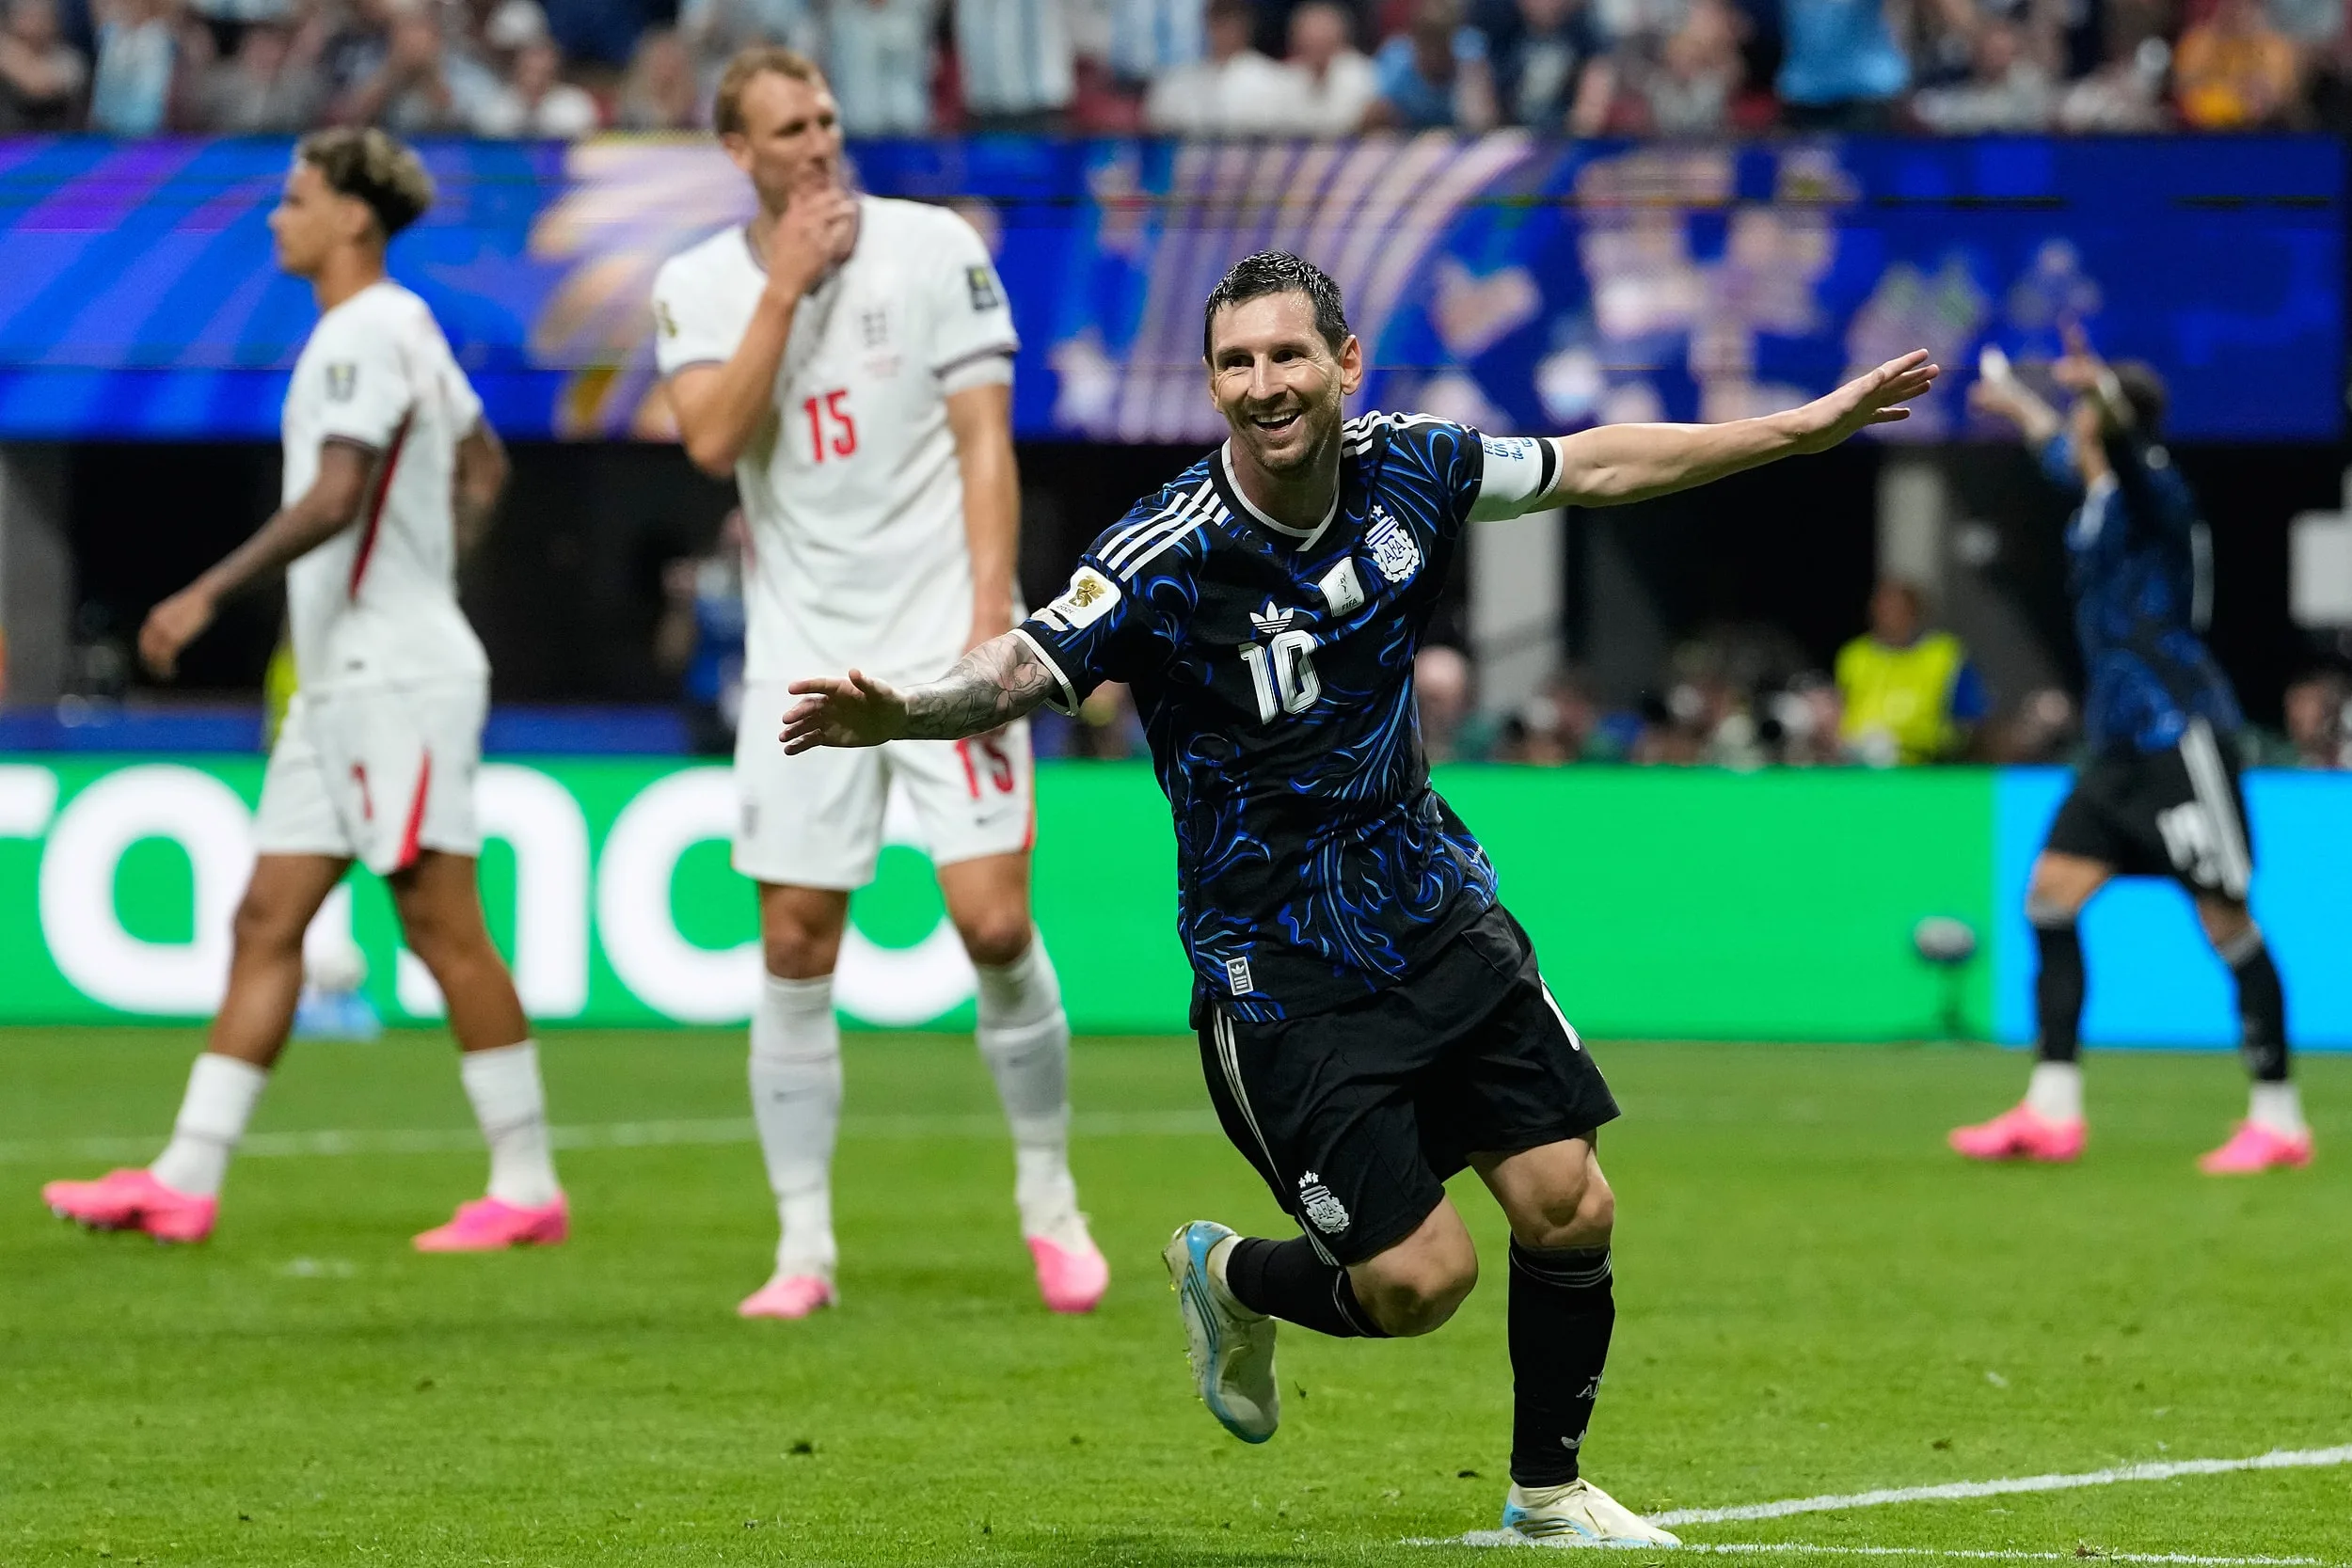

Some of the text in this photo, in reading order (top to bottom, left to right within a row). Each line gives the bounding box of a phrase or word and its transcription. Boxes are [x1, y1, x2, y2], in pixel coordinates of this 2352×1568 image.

[803, 388, 858, 465] 15
[1342, 597, 1359, 611] FIFA
[1238, 629, 1322, 725] 10
[954, 731, 1015, 800] 15
